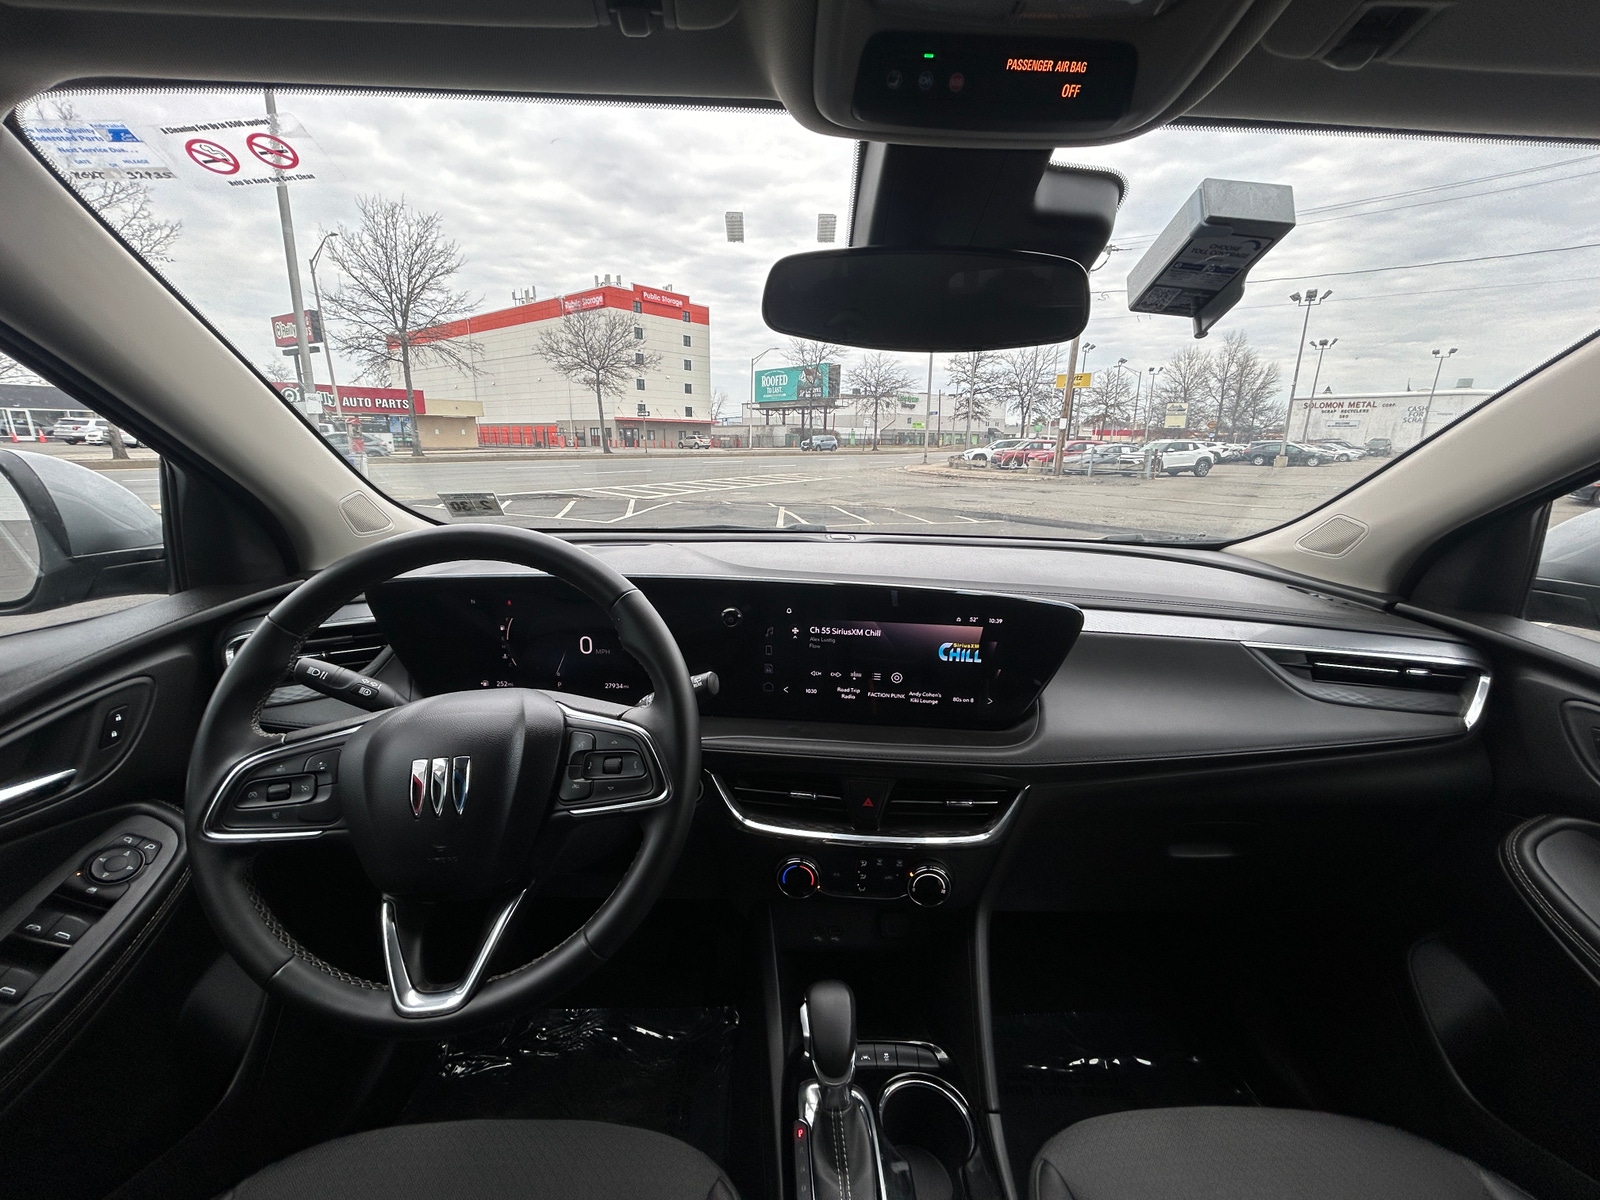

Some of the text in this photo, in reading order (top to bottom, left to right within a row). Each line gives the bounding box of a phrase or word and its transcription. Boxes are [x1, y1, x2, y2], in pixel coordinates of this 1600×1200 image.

[1006, 58, 1088, 73] PASSENGER AIR BAG
[1061, 83, 1082, 98] OFF
[63, 127, 95, 135] Quality
[166, 125, 198, 134] Cleaning
[225, 120, 245, 128] $500
[565, 294, 603, 310] Public Storage
[643, 291, 683, 307] Public Storage
[761, 375, 788, 387] ROOFED
[342, 396, 372, 407] AUTO
[375, 398, 409, 409] PARTS
[1303, 401, 1345, 409] SOLOMON
[1348, 401, 1378, 409] METAL
[809, 626, 882, 637] Ch 55 SiriusXM Chill
[580, 636, 593, 655] 0
[938, 642, 982, 663] CHILL
[797, 1129, 803, 1138] P
